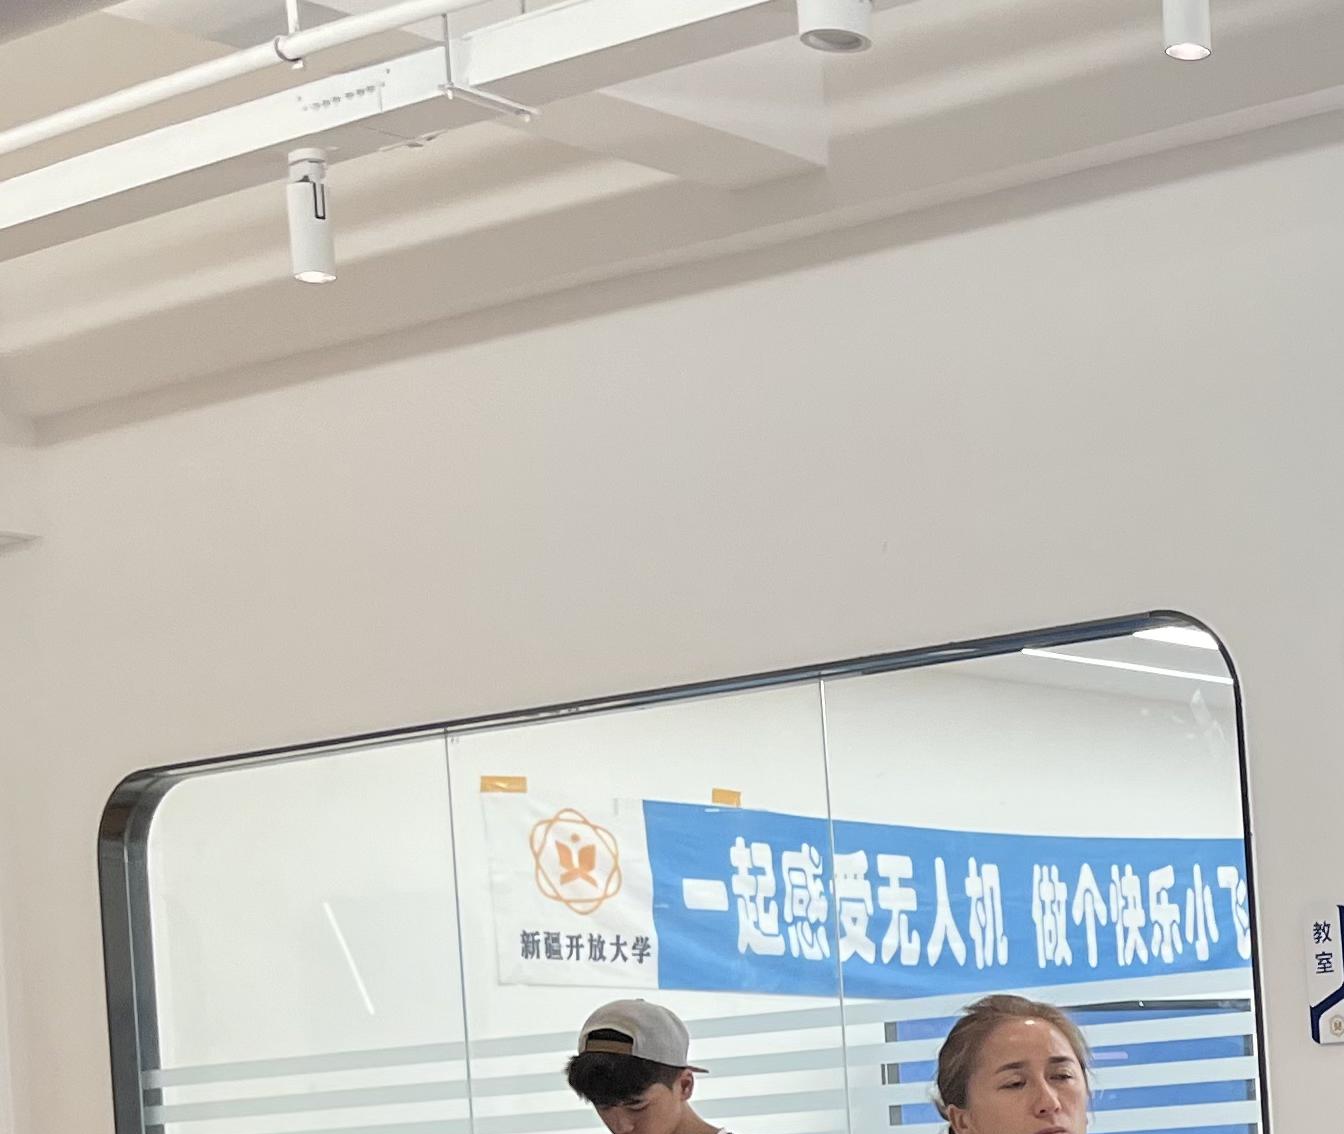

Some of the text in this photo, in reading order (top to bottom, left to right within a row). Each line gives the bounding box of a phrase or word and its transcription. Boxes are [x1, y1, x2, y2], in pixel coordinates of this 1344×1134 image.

[681, 835, 1009, 970] 一起感受无人机
[519, 929, 653, 964] 新疆开放大学
[1312, 919, 1336, 975] 教室
